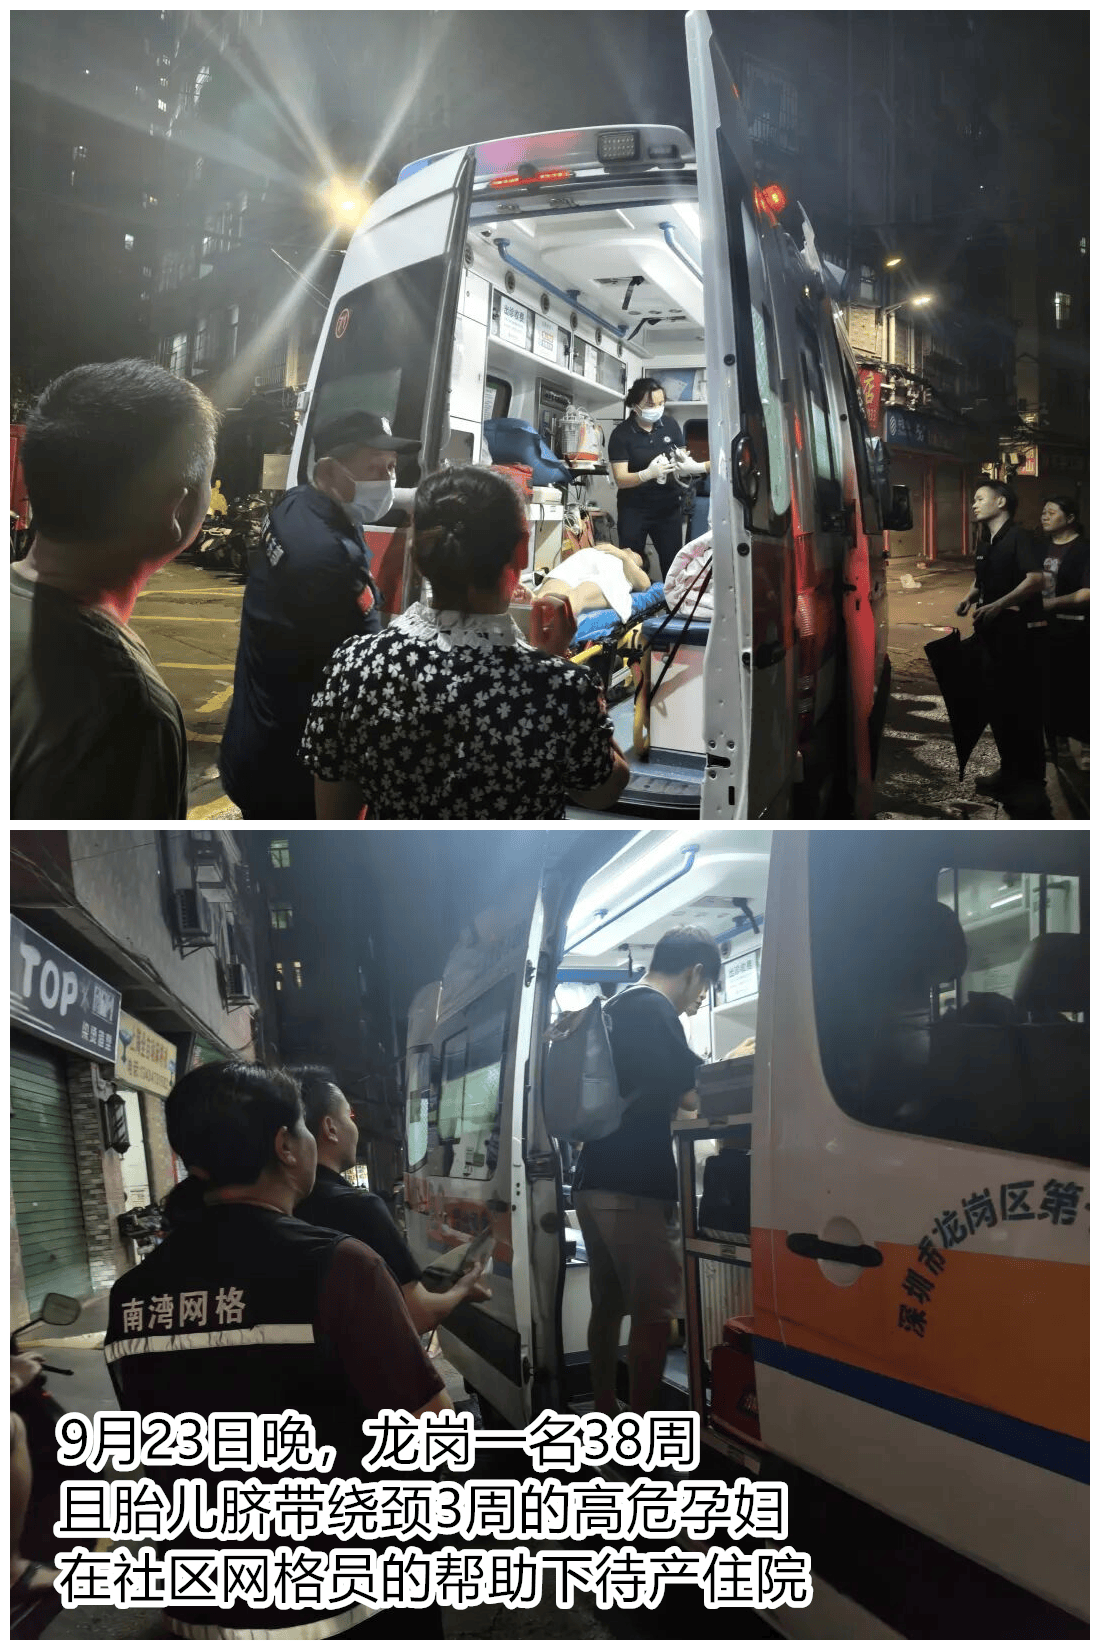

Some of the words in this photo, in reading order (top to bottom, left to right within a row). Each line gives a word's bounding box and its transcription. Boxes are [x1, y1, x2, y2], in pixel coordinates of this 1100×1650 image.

[19, 941, 79, 1017] TOP
[897, 1178, 1090, 1339] 深圳市龙岗区第
[121, 1286, 246, 1334] 南湾网格
